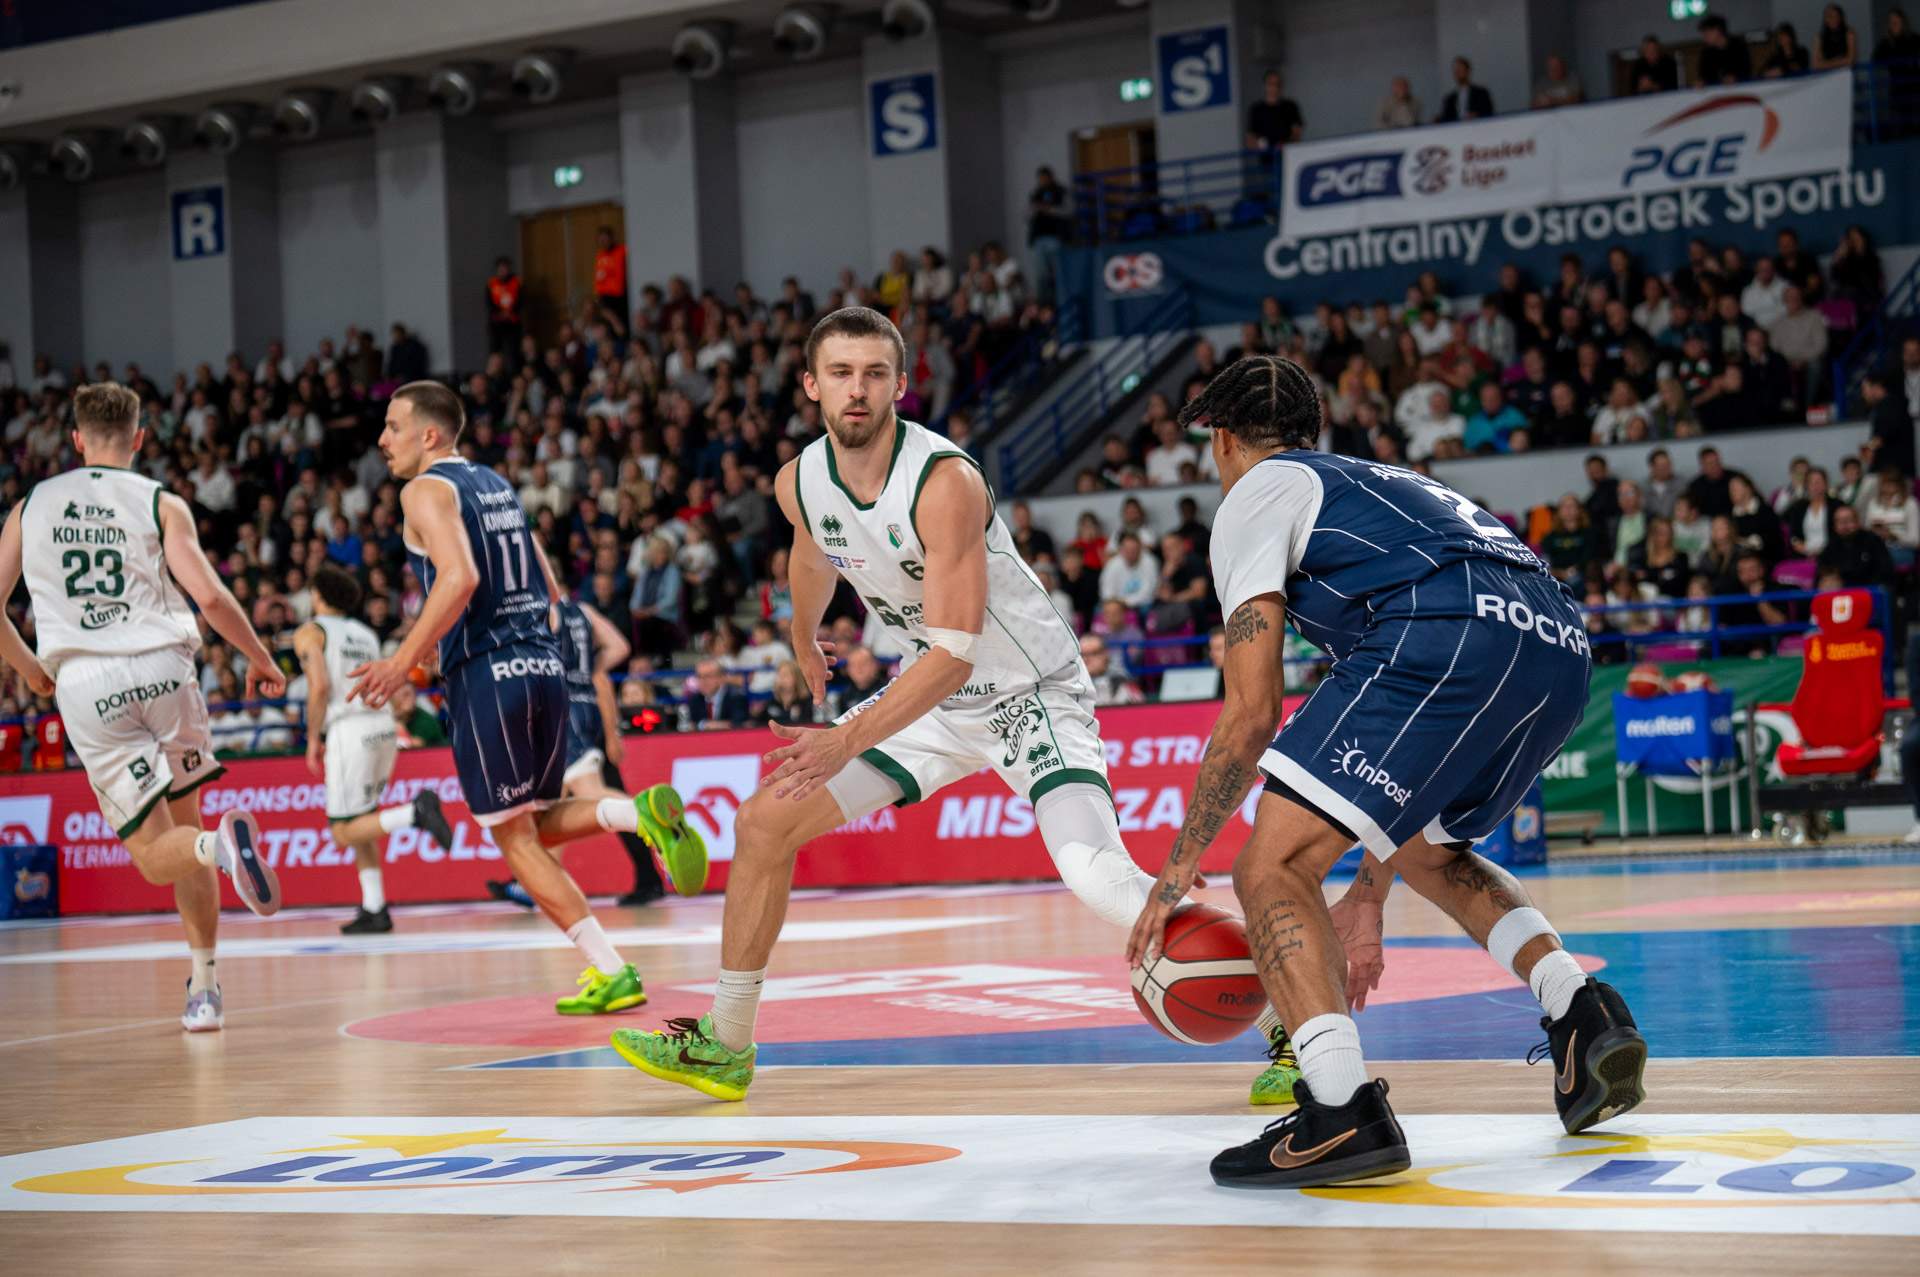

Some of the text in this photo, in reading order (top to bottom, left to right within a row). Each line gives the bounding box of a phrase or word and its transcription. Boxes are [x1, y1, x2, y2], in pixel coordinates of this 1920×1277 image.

[882, 92, 929, 151] S
[1462, 139, 1537, 163] Basket
[1622, 133, 1748, 187] PGE
[1310, 160, 1393, 200] PGE
[1462, 167, 1506, 189] Liga
[180, 203, 217, 256] R
[1264, 217, 1490, 279] Centralny
[1725, 168, 1885, 229] Sportu
[53, 527, 127, 544] KOLENDA
[824, 536, 848, 547] errea
[62, 549, 125, 599] 23
[90, 606, 121, 626] LOTTO
[984, 698, 1037, 734] UNIQA
[1626, 715, 1696, 738] molten
[1009, 715, 1029, 755] LOTTO
[1030, 757, 1060, 777] errea
[1354, 757, 1413, 807] InPost
[64, 812, 115, 842] ORL
[191, 1150, 785, 1183] LOTTO
